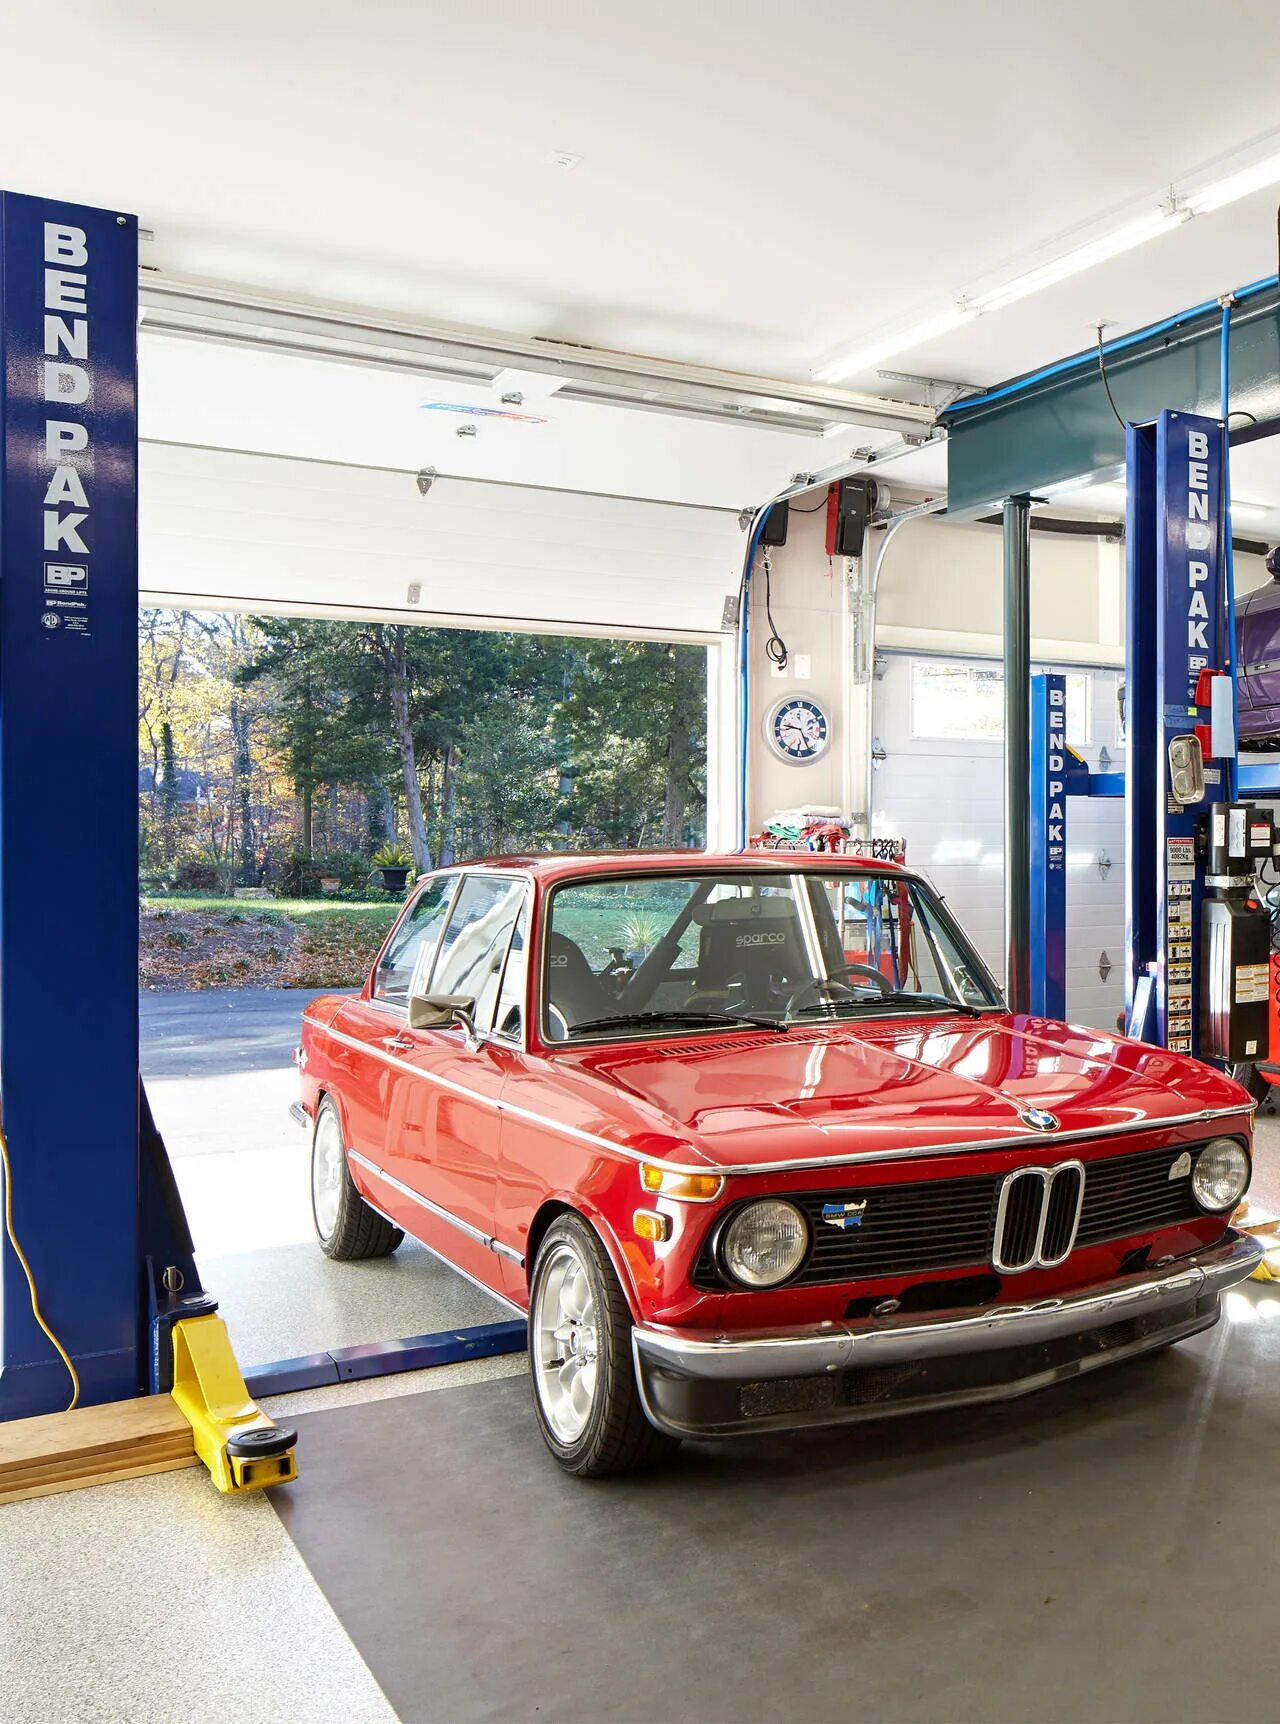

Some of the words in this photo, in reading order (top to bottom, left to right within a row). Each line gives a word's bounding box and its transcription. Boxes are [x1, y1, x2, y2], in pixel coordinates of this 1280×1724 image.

[44, 222, 91, 405] BEND
[43, 419, 91, 555] PAK
[1187, 430, 1211, 551] BEND
[47, 565, 86, 586] BP
[1187, 561, 1209, 649] PAK
[1049, 689, 1064, 772] BEND
[1048, 781, 1063, 841] PAK
[735, 932, 785, 948] sparco
